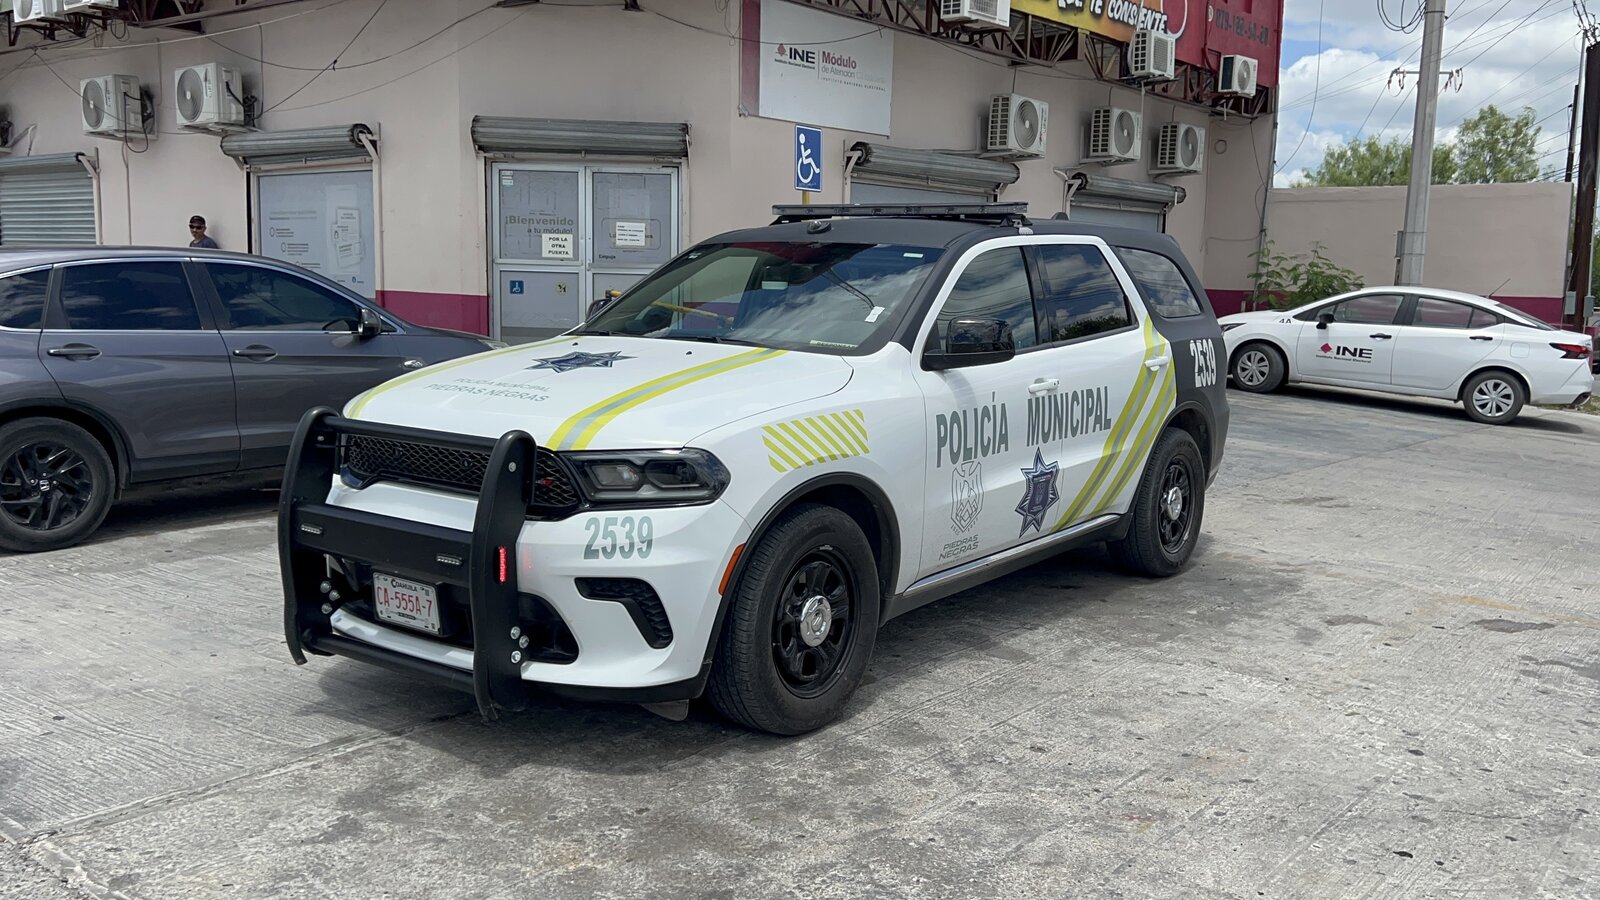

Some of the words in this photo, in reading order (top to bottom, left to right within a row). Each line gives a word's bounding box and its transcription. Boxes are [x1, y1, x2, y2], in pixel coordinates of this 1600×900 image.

[789, 47, 815, 65] INE
[822, 51, 857, 69] Módulo
[821, 65, 829, 73] de
[830, 66, 856, 78] Atención
[505, 215, 574, 226] ¡Bienvenido
[1336, 345, 1373, 359] INE
[1190, 339, 1216, 387] 2539
[424, 383, 487, 395] PIEDRAS
[484, 389, 550, 402] NEGRAS
[936, 392, 1008, 468] POLICÍA
[1027, 386, 1111, 447] MUNICIPAL
[584, 516, 653, 560] 2539
[943, 534, 979, 551] PIEDRAS
[939, 541, 979, 560] NEGRAS
[391, 578, 417, 592] COAHUILA
[376, 586, 432, 617] CA-555A-7
